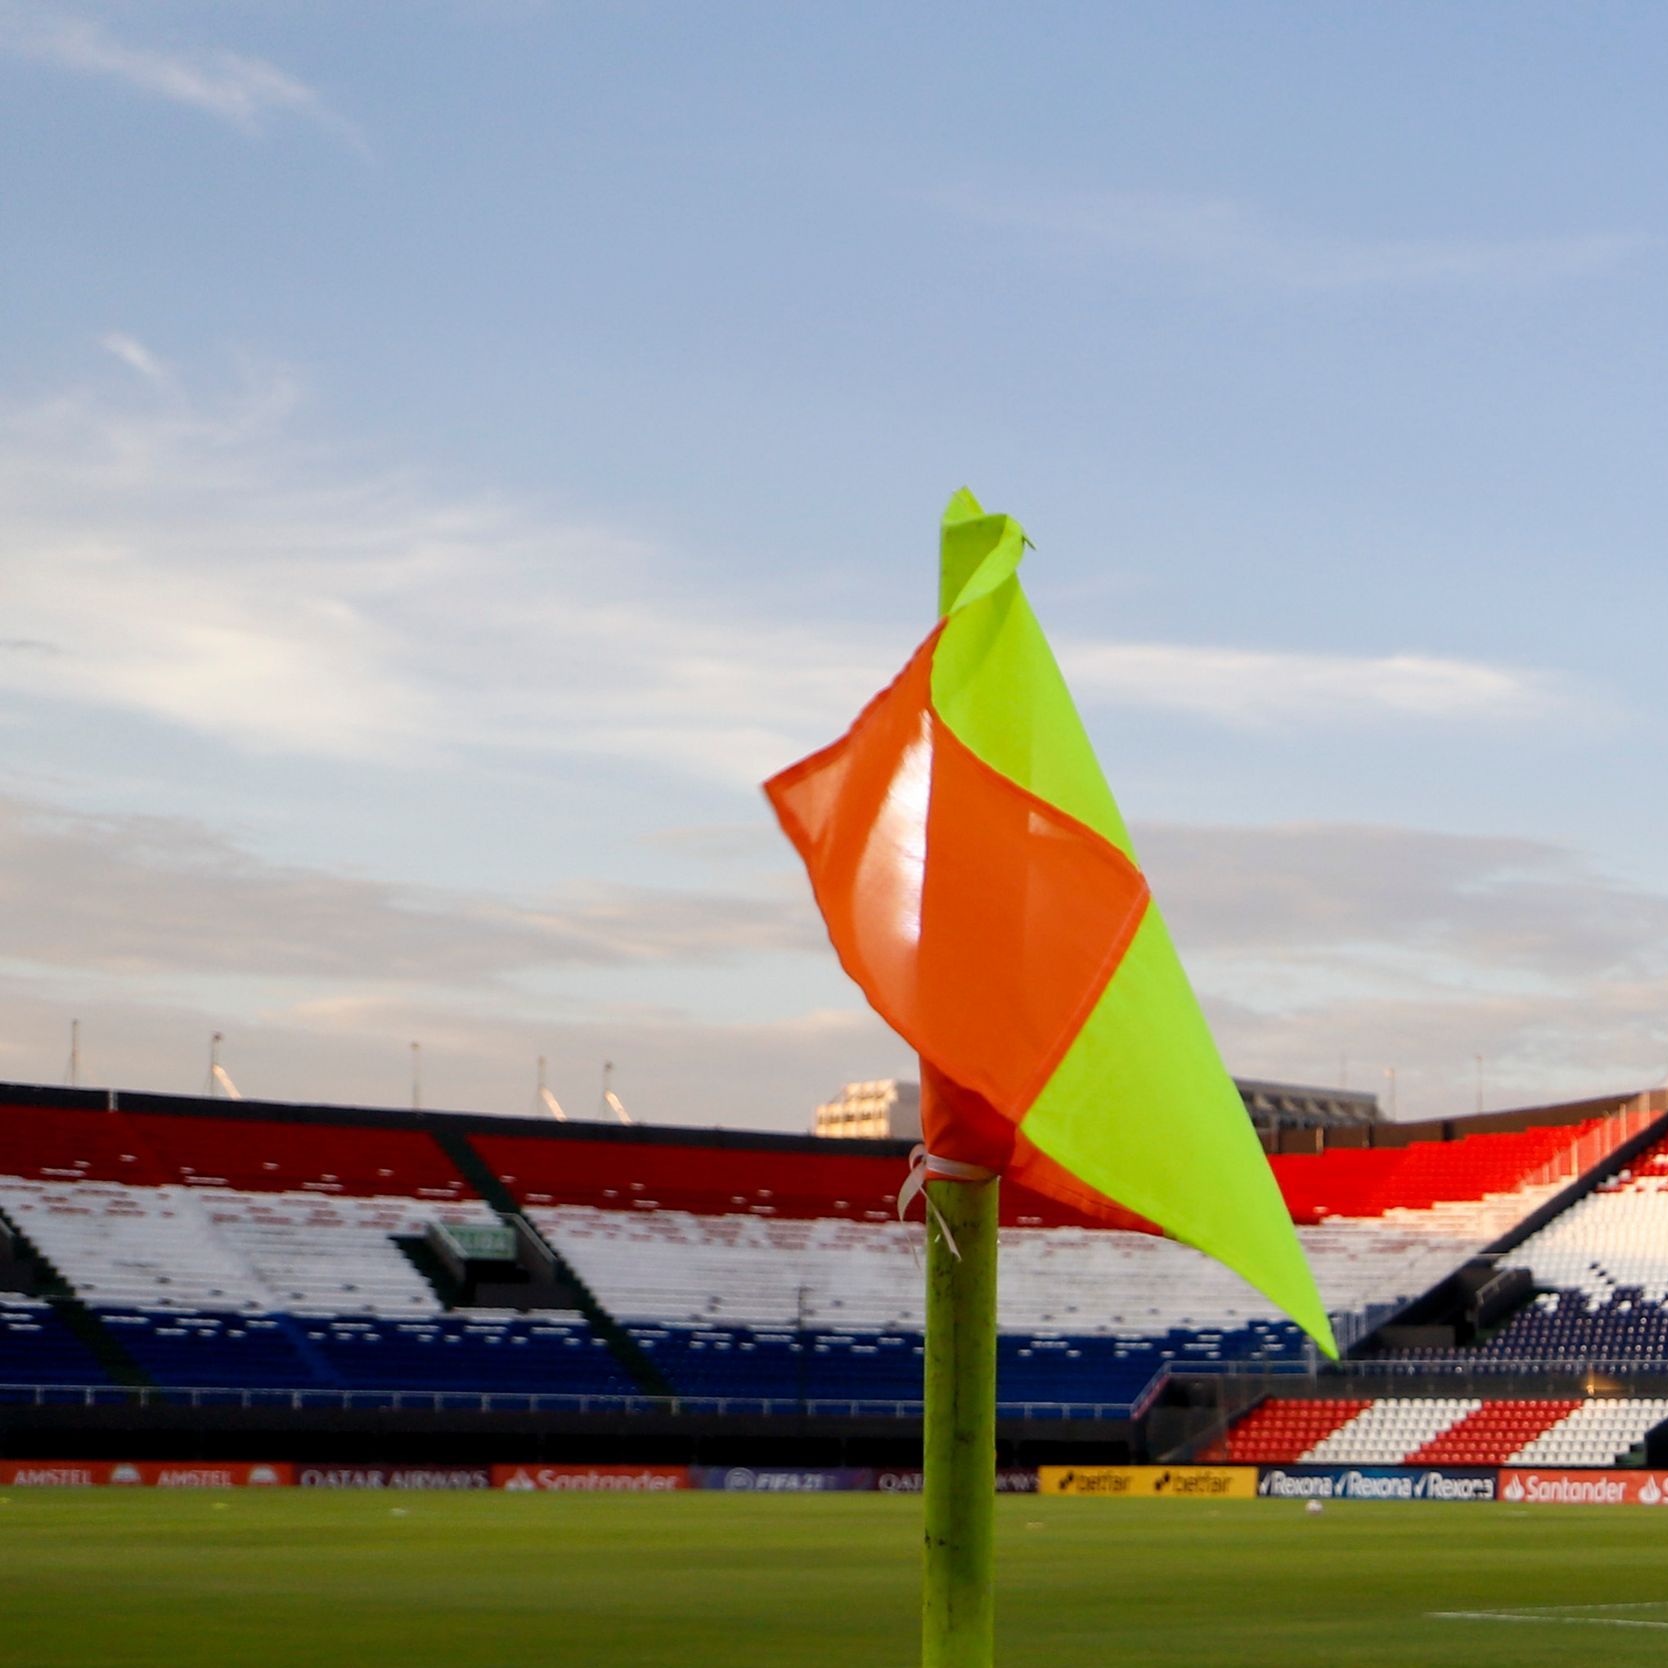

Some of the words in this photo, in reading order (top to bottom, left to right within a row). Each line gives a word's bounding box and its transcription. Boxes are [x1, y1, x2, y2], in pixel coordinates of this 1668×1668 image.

[14, 1469, 92, 1487] AMSTEL
[157, 1470, 232, 1488] AMSTEL
[301, 1470, 384, 1489] QATAR
[388, 1470, 490, 1489] AIRWAYS
[537, 1468, 680, 1490] Santander
[756, 1473, 800, 1491] FIFA
[1077, 1474, 1133, 1492] betfair
[1173, 1474, 1232, 1494] betfair
[1271, 1471, 1333, 1497] Rexona
[1345, 1471, 1412, 1497] Rexona
[1426, 1472, 1494, 1499] Rexona
[1526, 1476, 1627, 1502] Santander
